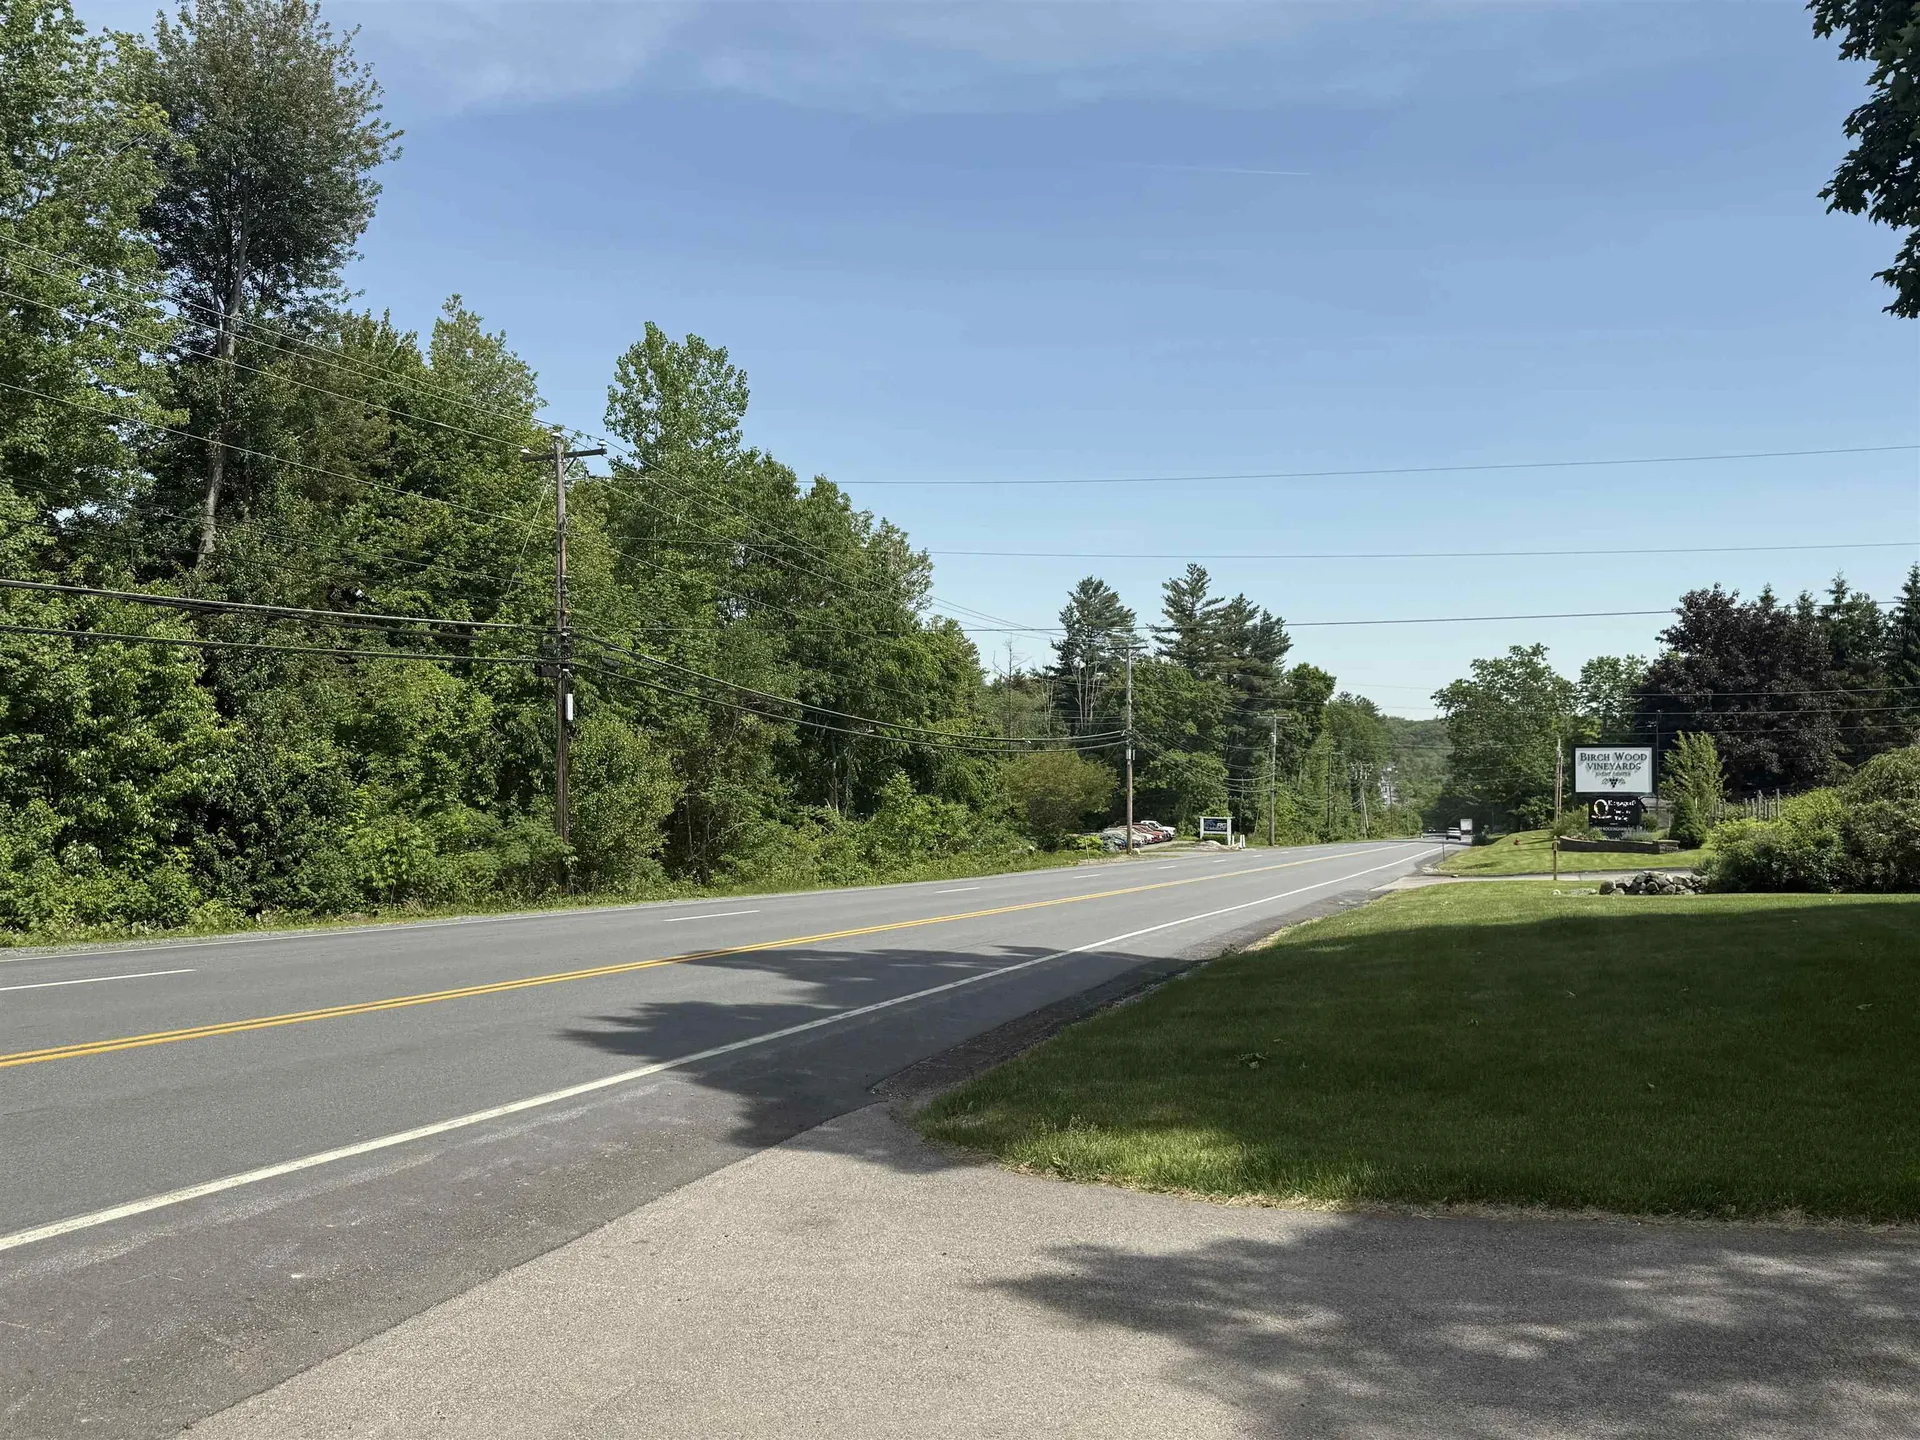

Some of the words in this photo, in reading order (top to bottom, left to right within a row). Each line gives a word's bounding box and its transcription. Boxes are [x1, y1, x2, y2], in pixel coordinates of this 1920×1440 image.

[1580, 752, 1610, 761] BIRCH
[1614, 752, 1648, 761] WOOD
[1587, 762, 1642, 770] VINEYARDS
